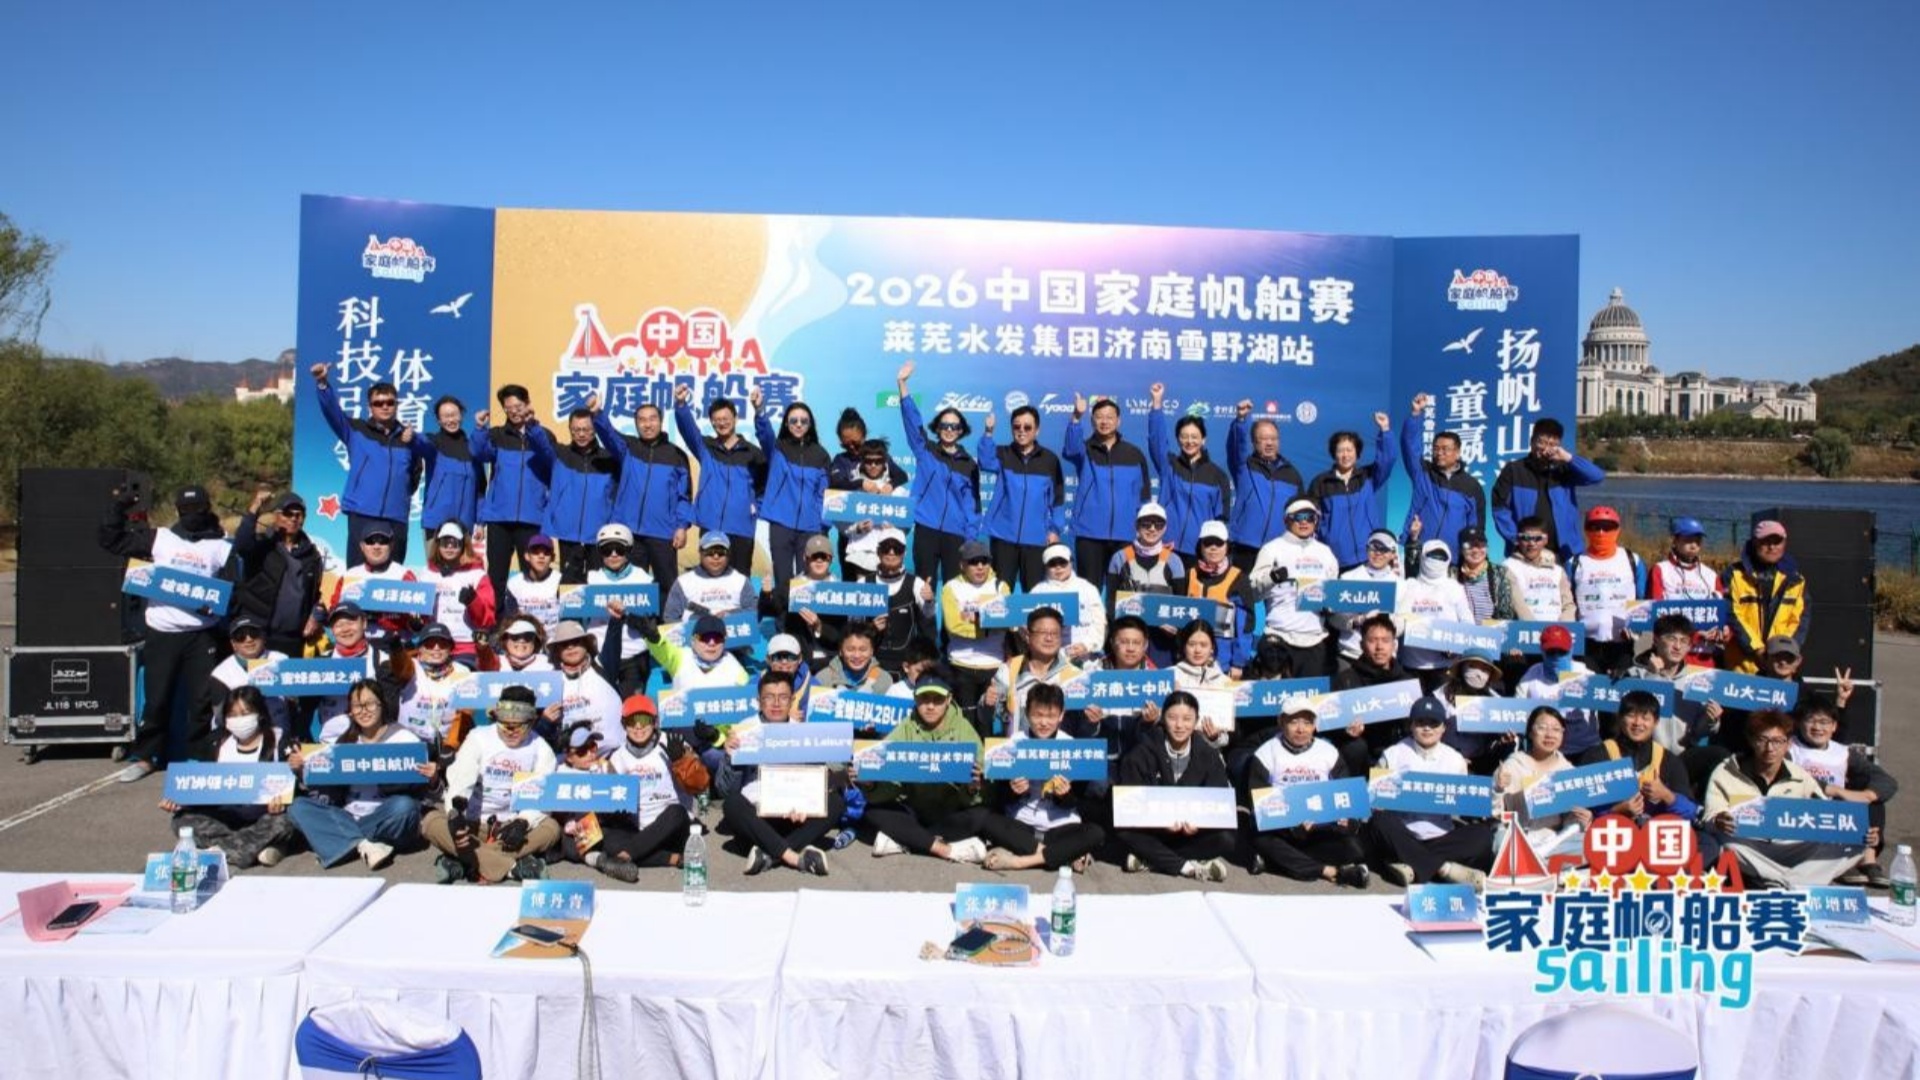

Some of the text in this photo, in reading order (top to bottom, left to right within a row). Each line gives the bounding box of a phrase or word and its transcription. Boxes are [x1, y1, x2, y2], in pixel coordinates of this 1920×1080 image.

[847, 270, 1354, 326] 2026中国家庭帆船赛
[646, 313, 725, 350] 中国
[883, 320, 1315, 366] 莱芜水发集团济南雪野湖站
[1496, 328, 1542, 474] 扬帆山
[856, 501, 908, 518] 台北神话
[1339, 590, 1381, 605] 大山队
[1158, 604, 1200, 620] 星环号
[1092, 681, 1173, 698] 济南七中队
[1724, 683, 1787, 706] 山大二队
[765, 737, 800, 749] Sports
[803, 736, 812, 747] &
[918, 762, 941, 774] 一队
[1049, 760, 1072, 771] 四队
[1434, 794, 1457, 805] 二队
[1587, 785, 1609, 798] 三队
[1777, 811, 1858, 831] 山大三队
[530, 891, 584, 910] 傅丹青
[1422, 896, 1466, 912] 张凯
